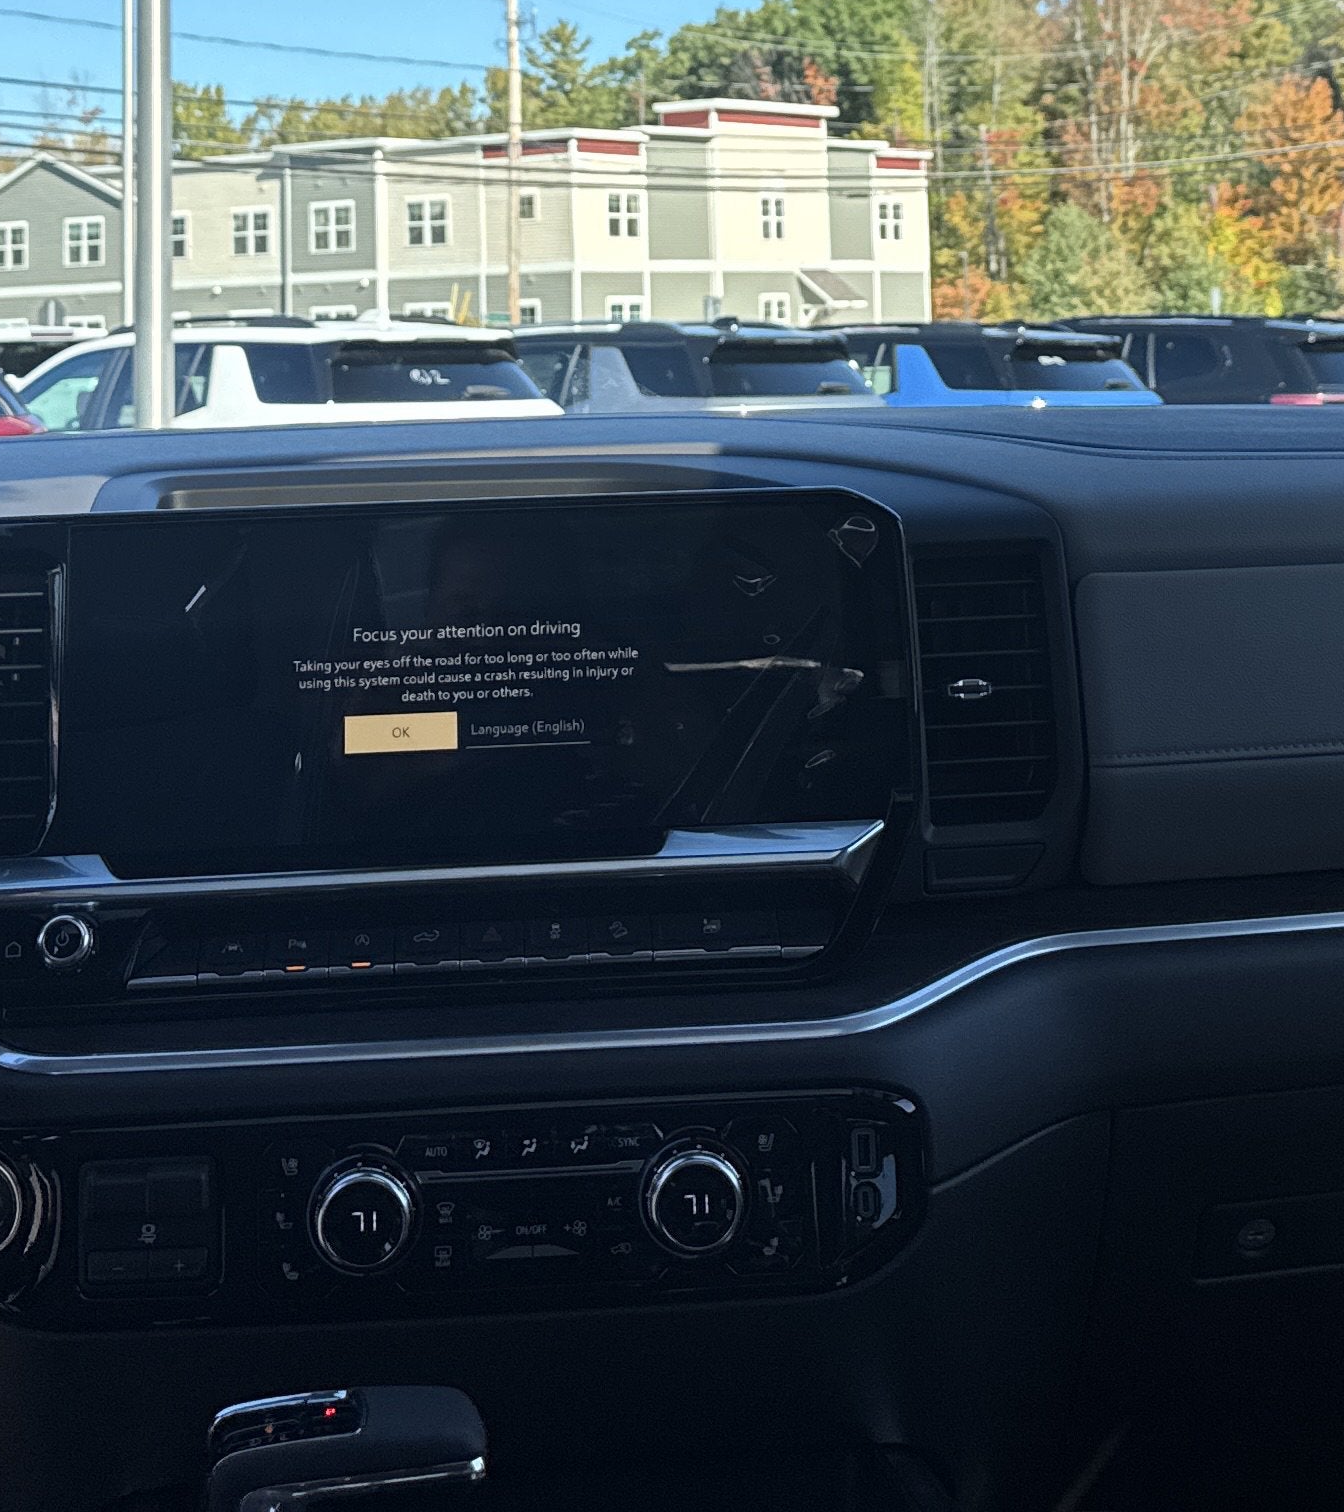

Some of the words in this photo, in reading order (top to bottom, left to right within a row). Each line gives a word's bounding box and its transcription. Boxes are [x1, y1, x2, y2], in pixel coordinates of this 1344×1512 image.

[353, 627, 397, 643] Focus
[400, 627, 433, 644] your
[437, 623, 504, 639] attention
[508, 624, 526, 636] on
[530, 619, 580, 638] driving
[293, 660, 331, 674] Taking
[334, 660, 360, 672] your
[363, 659, 390, 671] eyes
[393, 657, 411, 668] off
[413, 656, 432, 668] the
[435, 655, 462, 667] road
[465, 654, 481, 665] for
[484, 653, 504, 665] too
[507, 652, 533, 666] long
[536, 653, 548, 663] or
[551, 651, 571, 662] too
[574, 649, 605, 661] often
[608, 647, 639, 660] while
[299, 678, 331, 692] using
[334, 676, 356, 688] this
[358, 675, 400, 689] system
[403, 673, 435, 685] could
[438, 673, 471, 684] cause
[475, 673, 481, 682] a
[484, 670, 516, 682] crash
[519, 668, 569, 683] resulting
[572, 668, 583, 678] in
[586, 666, 618, 680] injury
[621, 667, 633, 676] or
[402, 690, 435, 702] death
[438, 690, 450, 701] to
[452, 691, 474, 702] you
[477, 690, 489, 699] or
[492, 686, 534, 699] others.
[392, 727, 410, 738] OK
[471, 722, 529, 738] Language
[532, 719, 584, 736] (English)
[425, 1146, 448, 1158] AUTO
[618, 1136, 640, 1148] SYNC
[516, 1223, 548, 1236] ON/OFF
